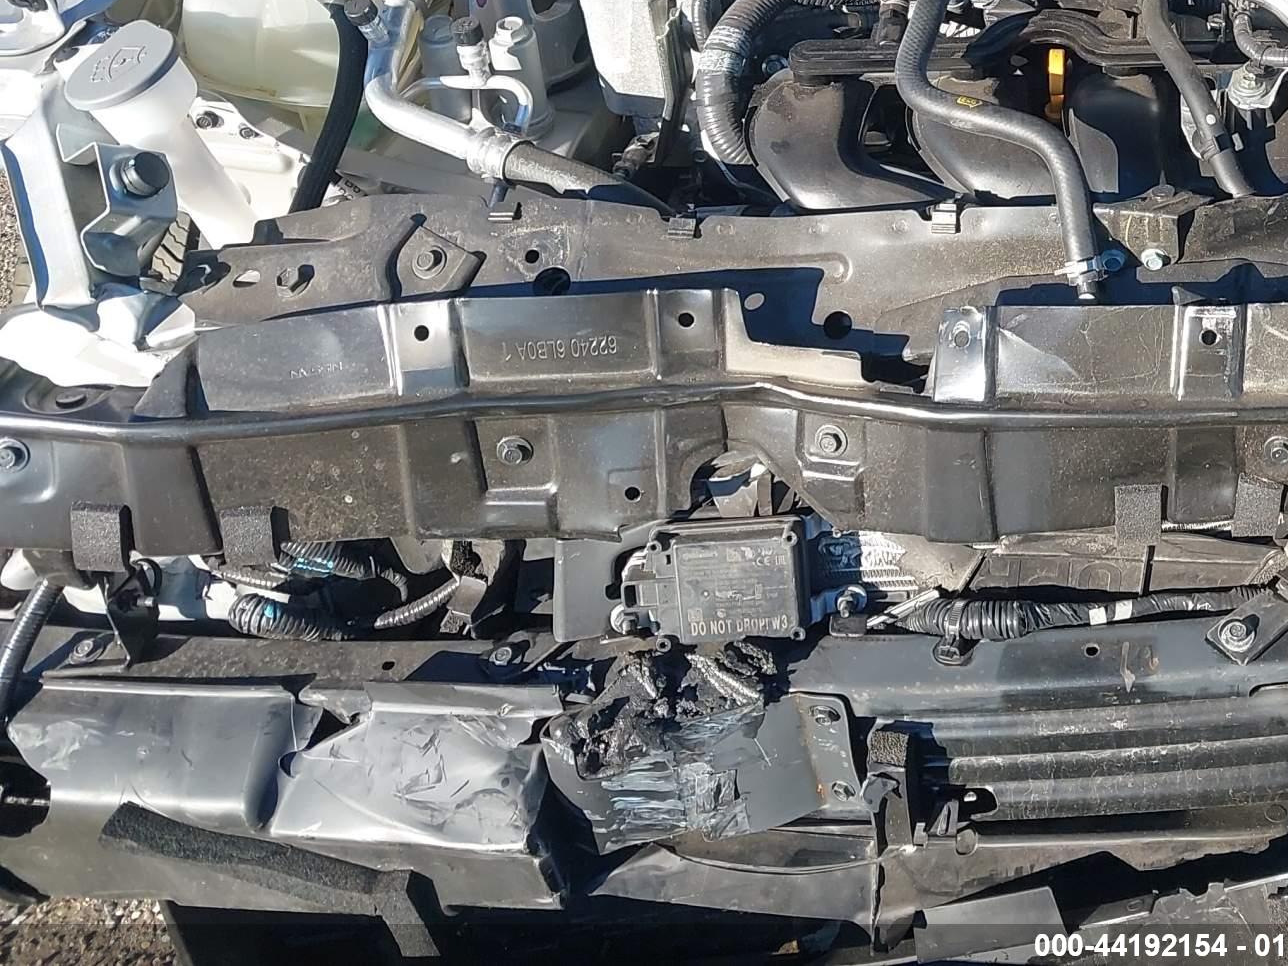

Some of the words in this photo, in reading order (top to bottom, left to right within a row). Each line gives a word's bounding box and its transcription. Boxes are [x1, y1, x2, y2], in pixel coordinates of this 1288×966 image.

[570, 335, 617, 357] 62240
[690, 621, 707, 636] DO
[710, 619, 732, 634] NOT
